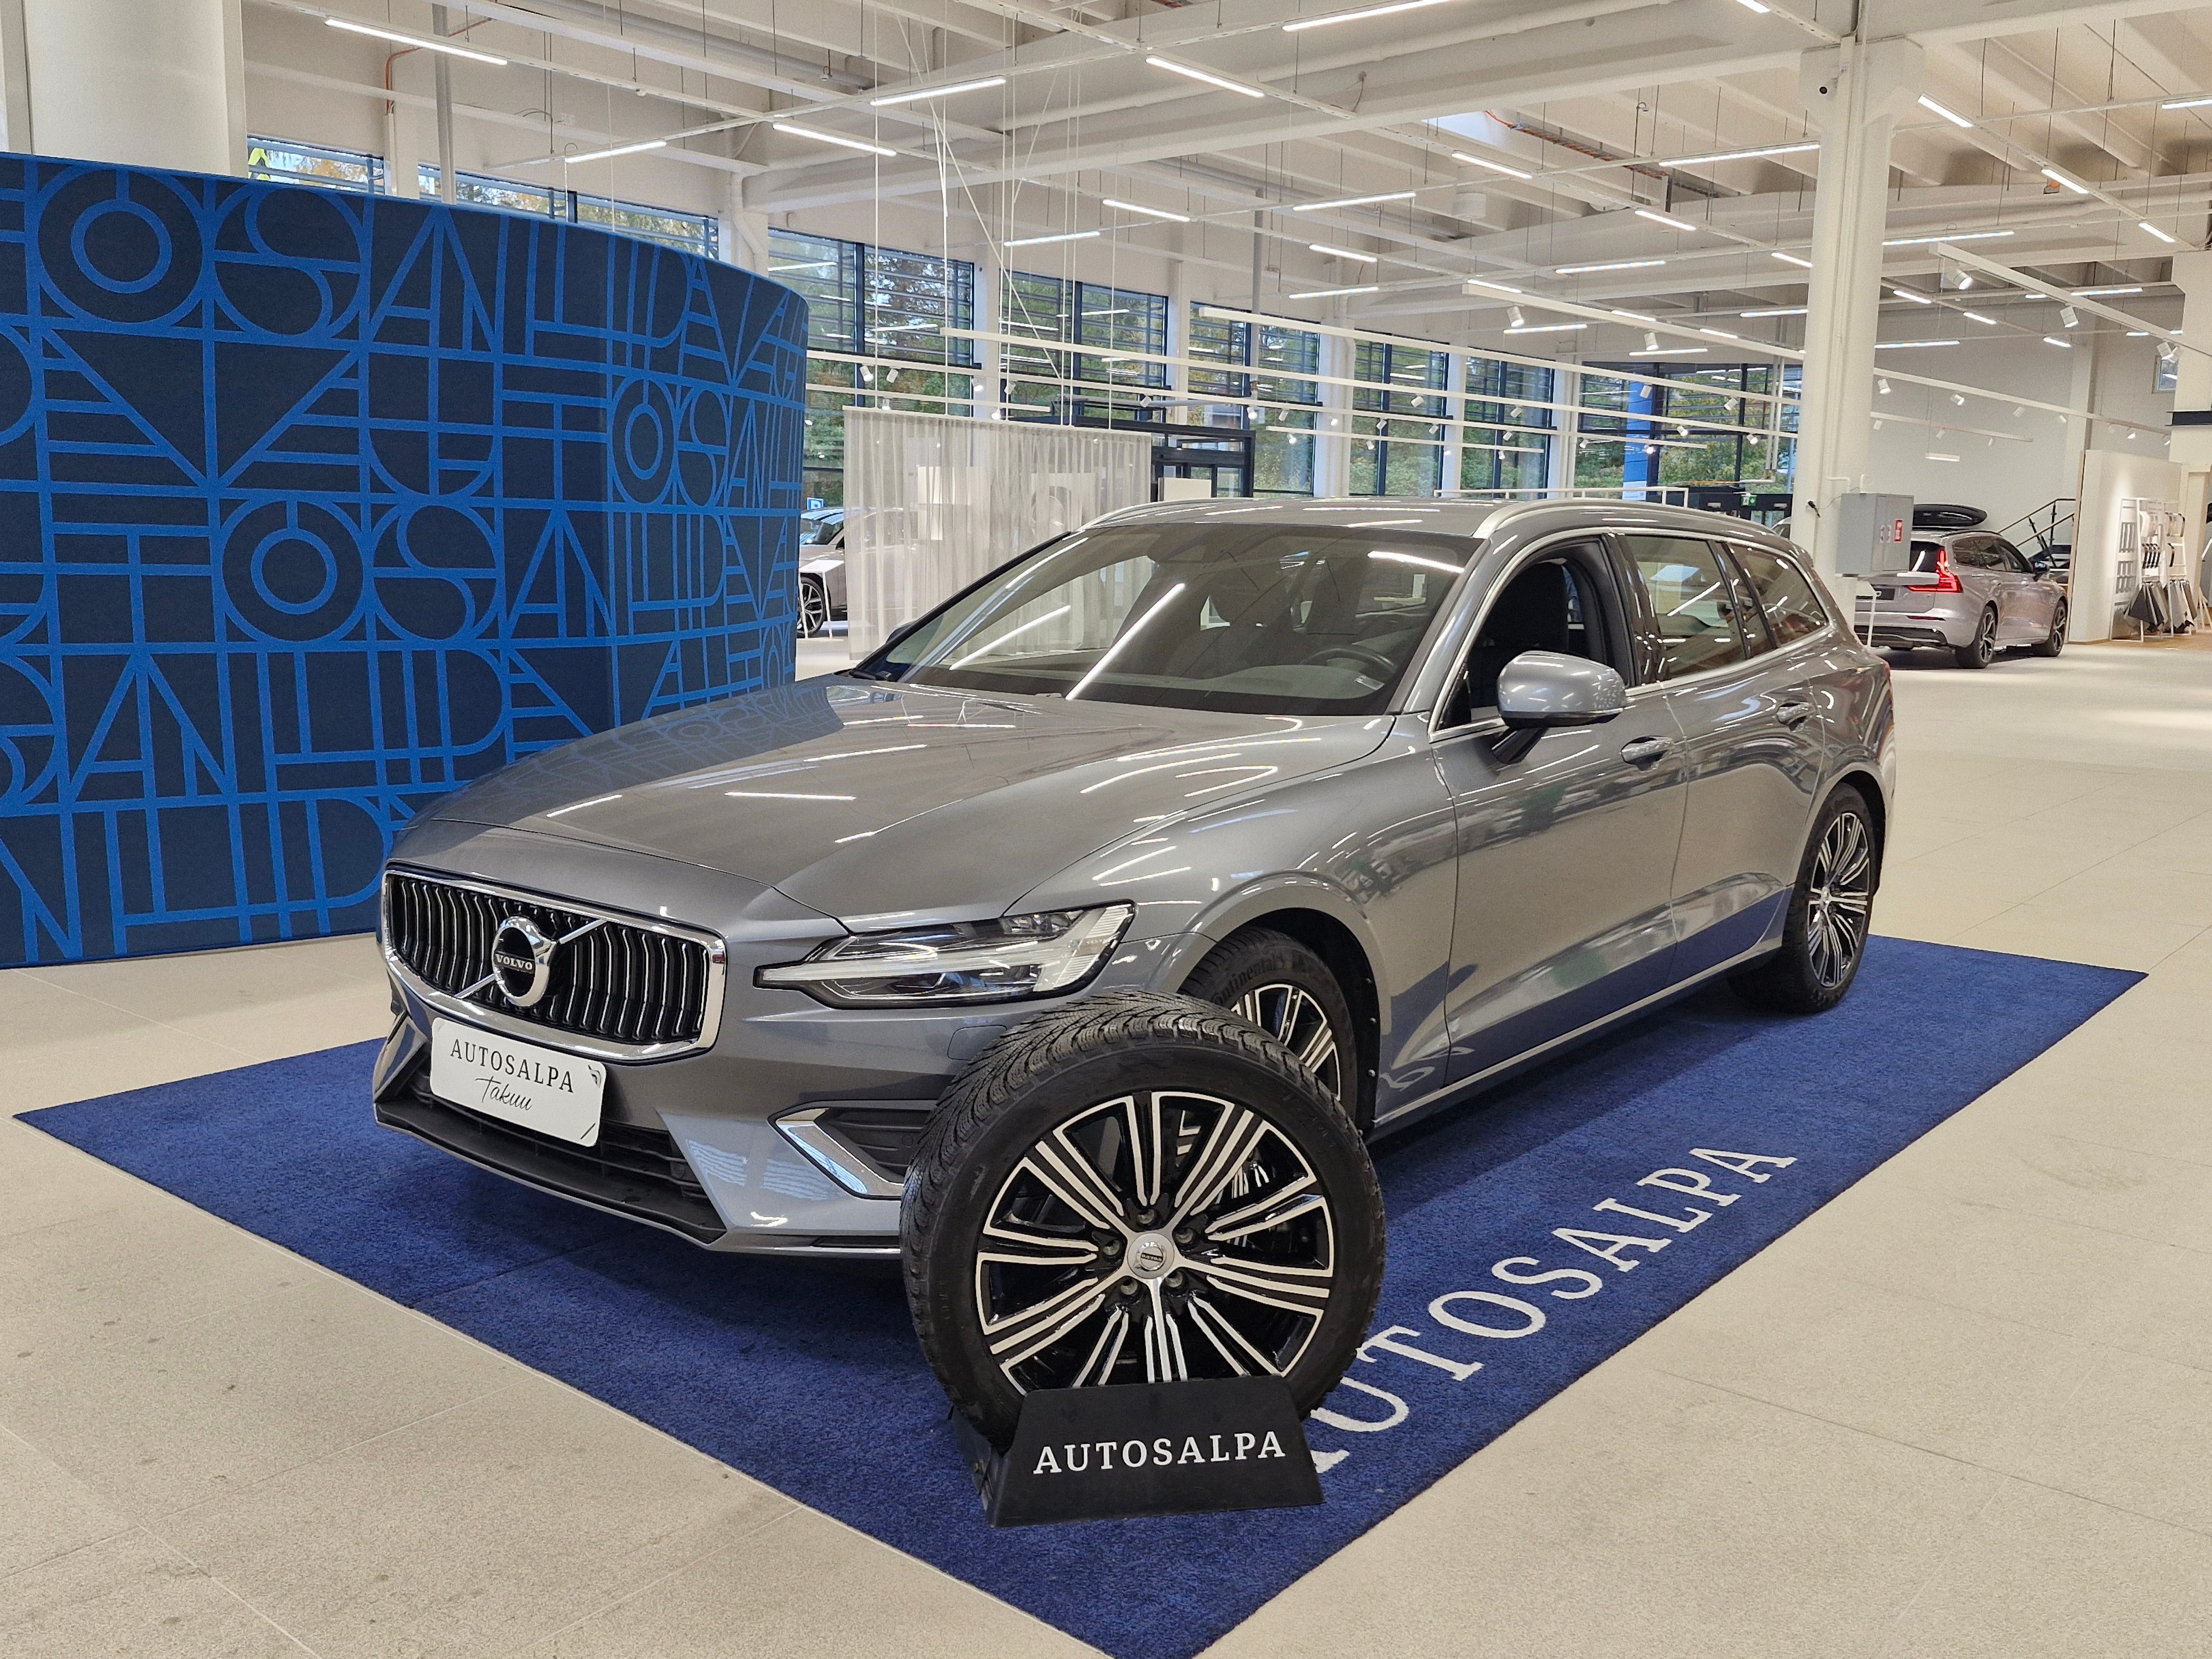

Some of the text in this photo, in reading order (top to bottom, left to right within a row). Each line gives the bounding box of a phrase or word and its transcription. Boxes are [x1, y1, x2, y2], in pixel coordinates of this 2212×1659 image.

[495, 953, 533, 970] VOLVO
[450, 1039, 573, 1093] AUTOSALPA
[474, 1076, 533, 1111] Takuu
[1032, 1431, 1286, 1474] AUTOSALPA
